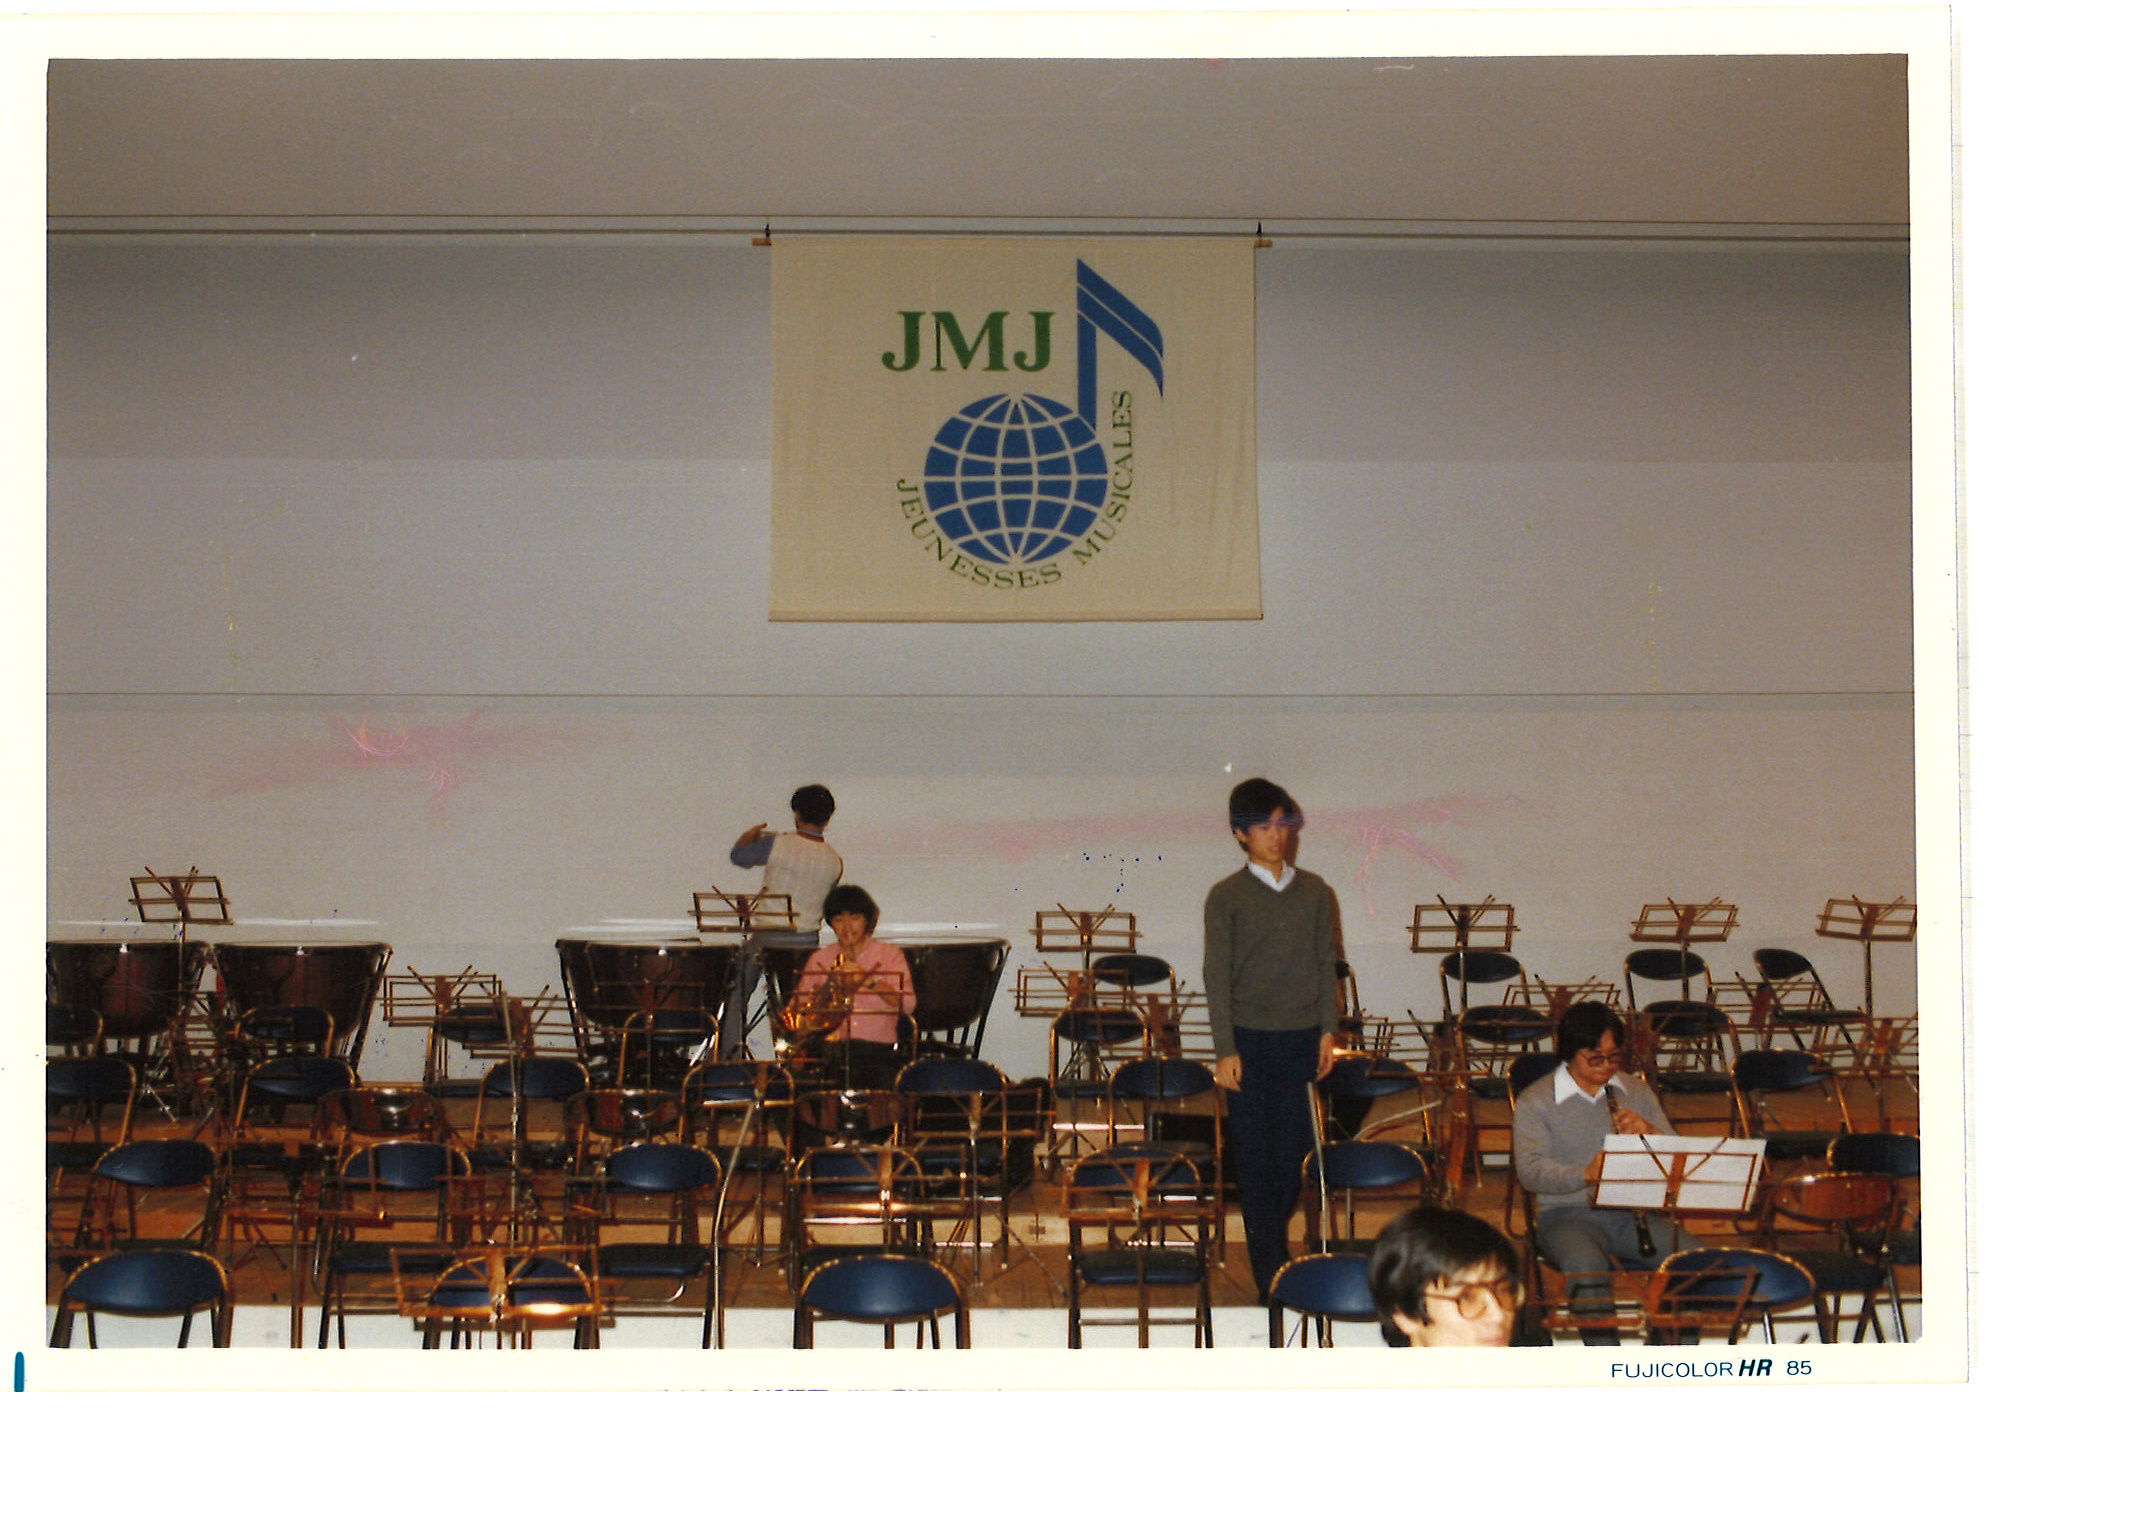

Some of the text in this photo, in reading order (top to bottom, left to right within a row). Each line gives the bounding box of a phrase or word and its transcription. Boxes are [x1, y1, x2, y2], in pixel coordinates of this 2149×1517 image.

[881, 310, 1055, 372] JMJ
[896, 389, 1134, 590] JEUNESSES MUSICALES
